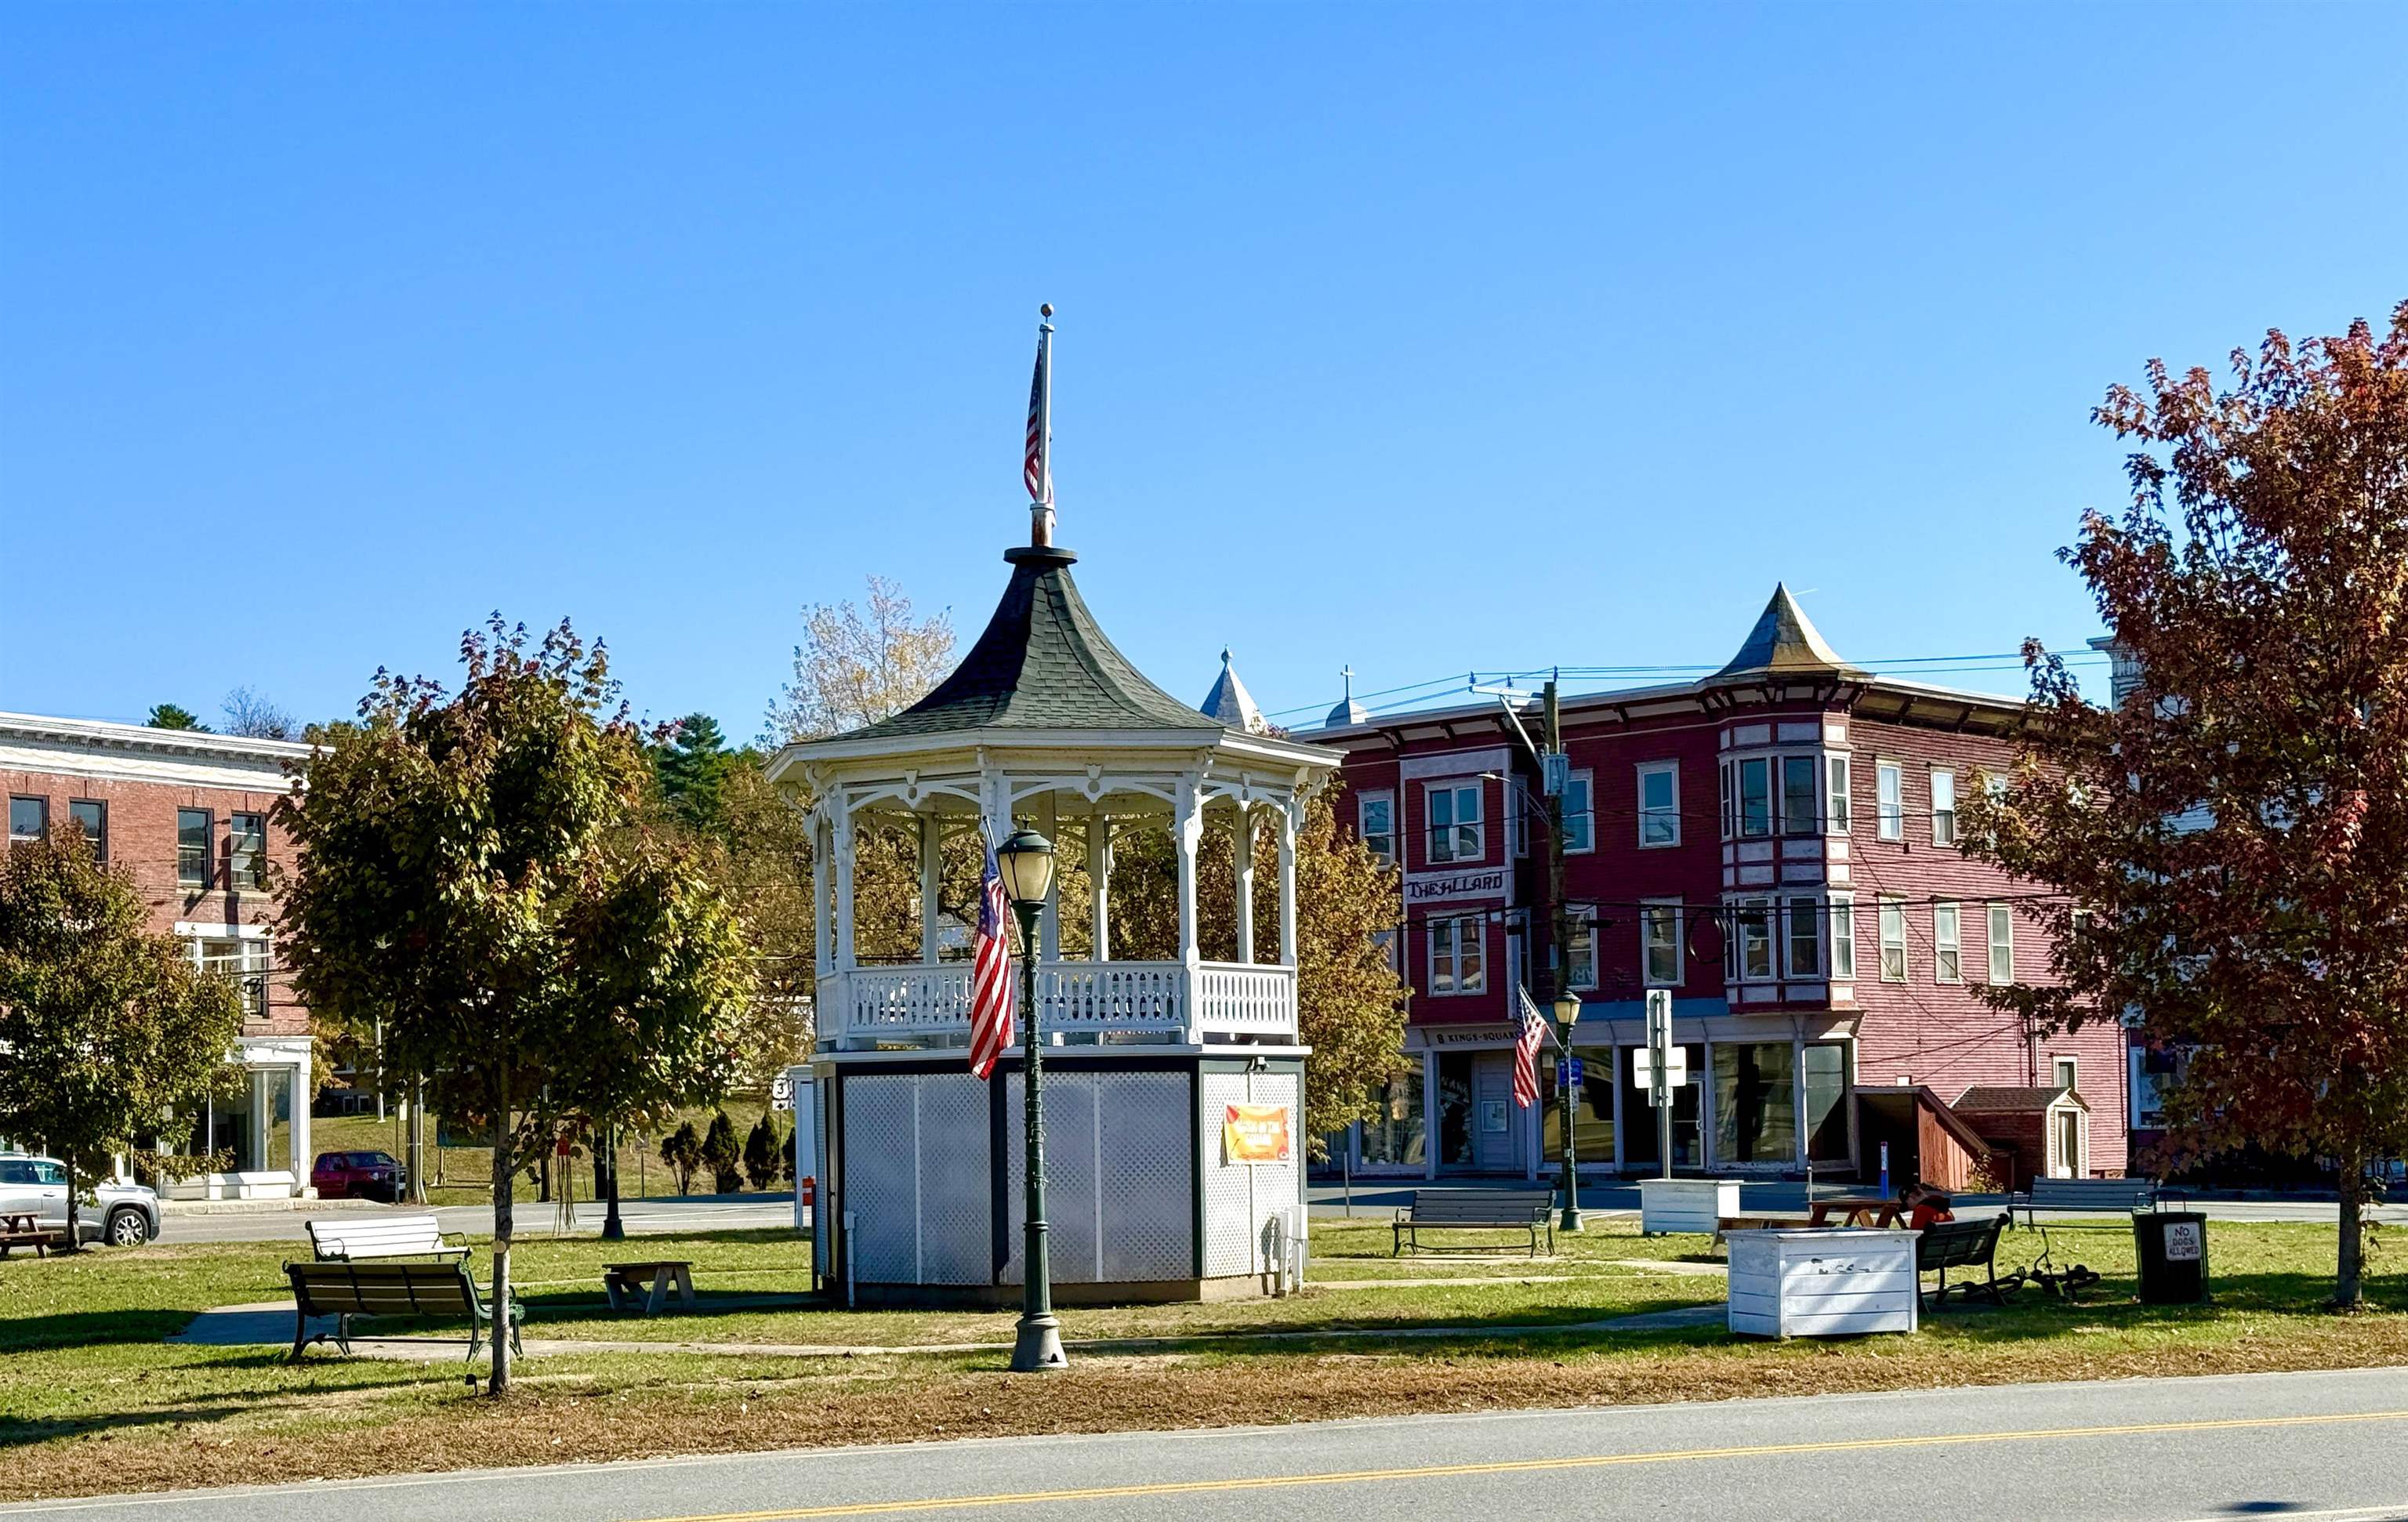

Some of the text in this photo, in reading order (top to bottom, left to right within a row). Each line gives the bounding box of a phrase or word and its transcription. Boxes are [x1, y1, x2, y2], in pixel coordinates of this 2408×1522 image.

[1437, 1034, 1445, 1045] 8
[777, 1083, 784, 1094] 3
[2175, 1227, 2190, 1236] NO
[2173, 1238, 2194, 1246] DOGS
[2169, 1246, 2199, 1256] ALLOWED
